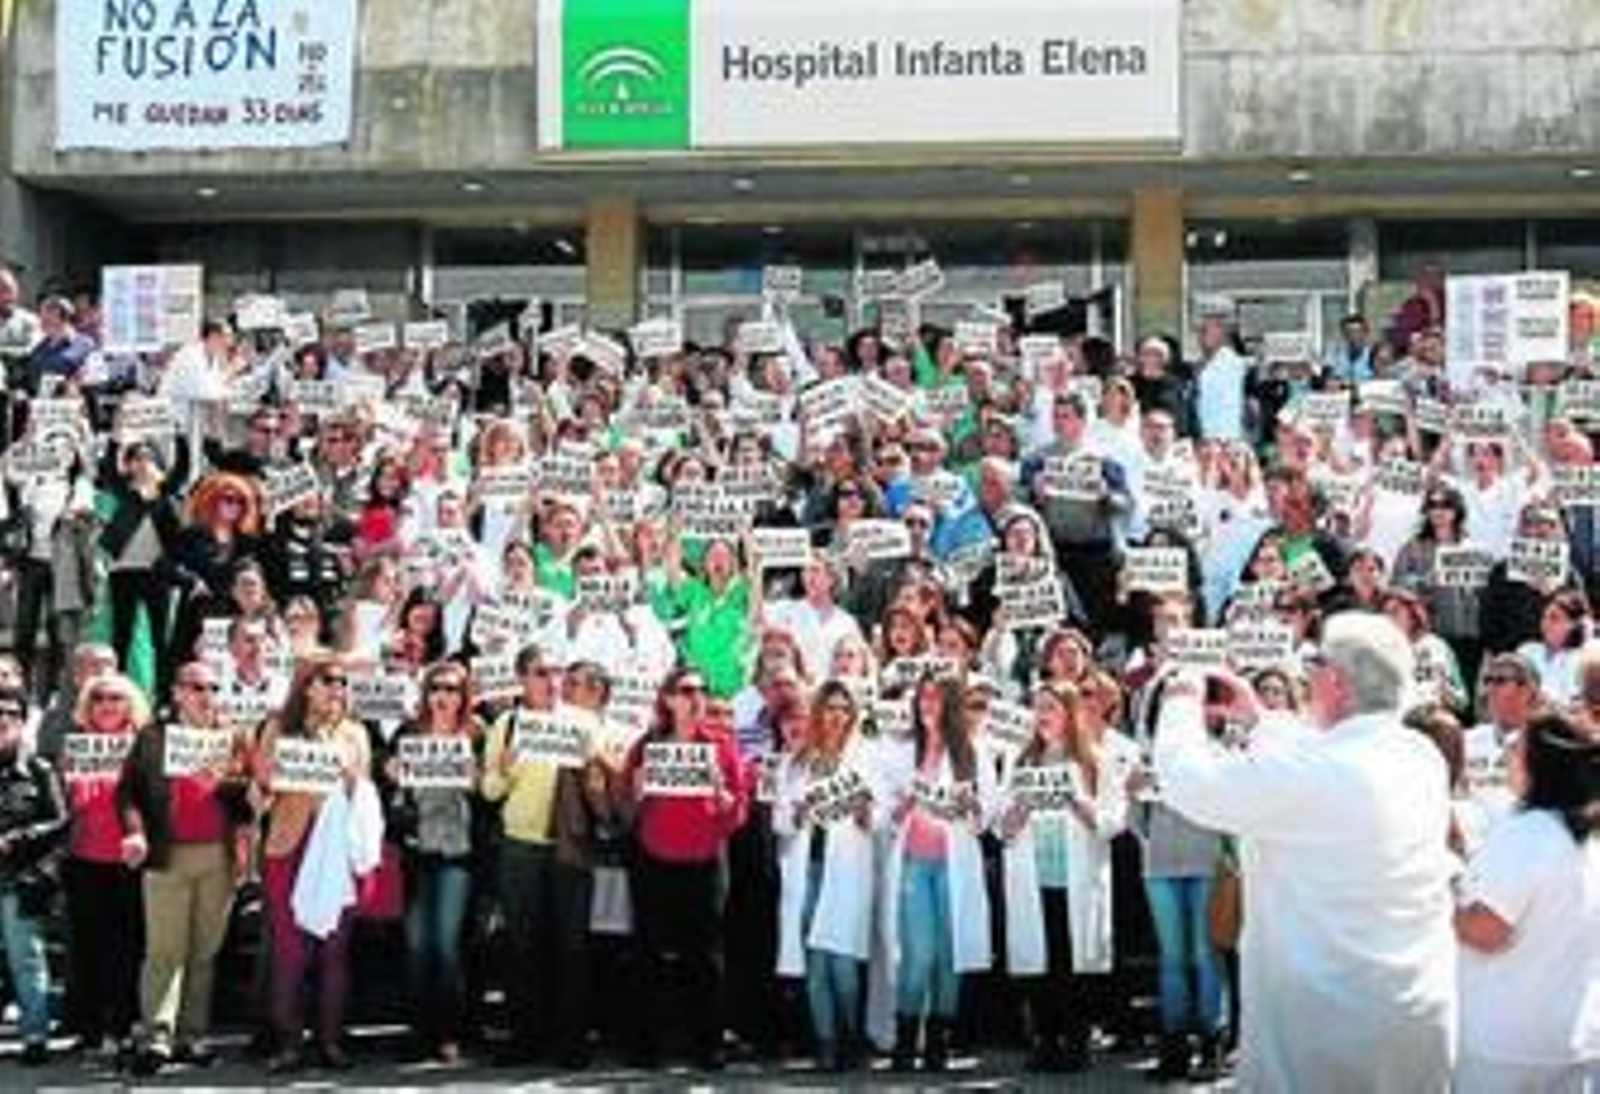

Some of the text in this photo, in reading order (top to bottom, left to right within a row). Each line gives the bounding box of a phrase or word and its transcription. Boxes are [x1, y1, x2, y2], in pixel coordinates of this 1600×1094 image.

[104, 0, 157, 32] NO
[172, 0, 198, 28] A
[722, 38, 1148, 87] Hospital Infanta Elena
[242, 99, 271, 124] 33
